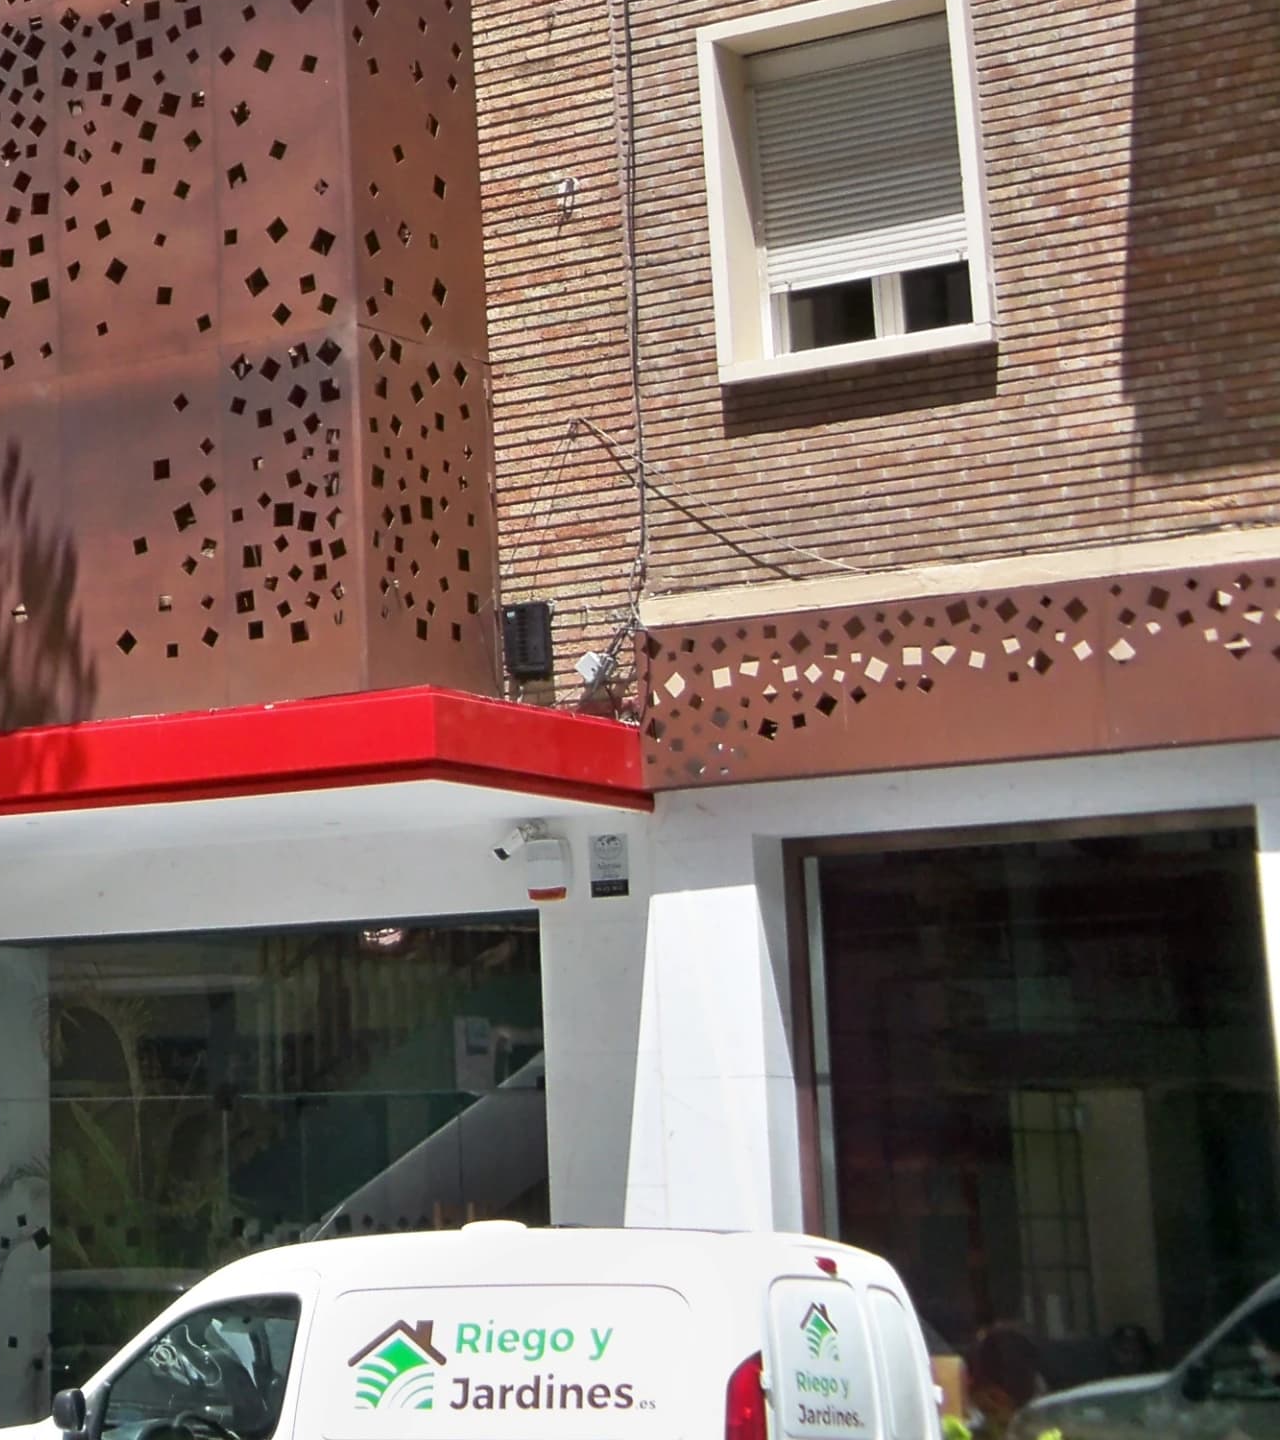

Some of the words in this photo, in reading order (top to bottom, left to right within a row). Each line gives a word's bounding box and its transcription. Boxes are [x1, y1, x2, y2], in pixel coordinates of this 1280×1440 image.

[455, 1319, 575, 1362] Riego
[588, 1327, 614, 1361] y
[795, 1370, 839, 1397] Riego
[840, 1377, 849, 1400] y
